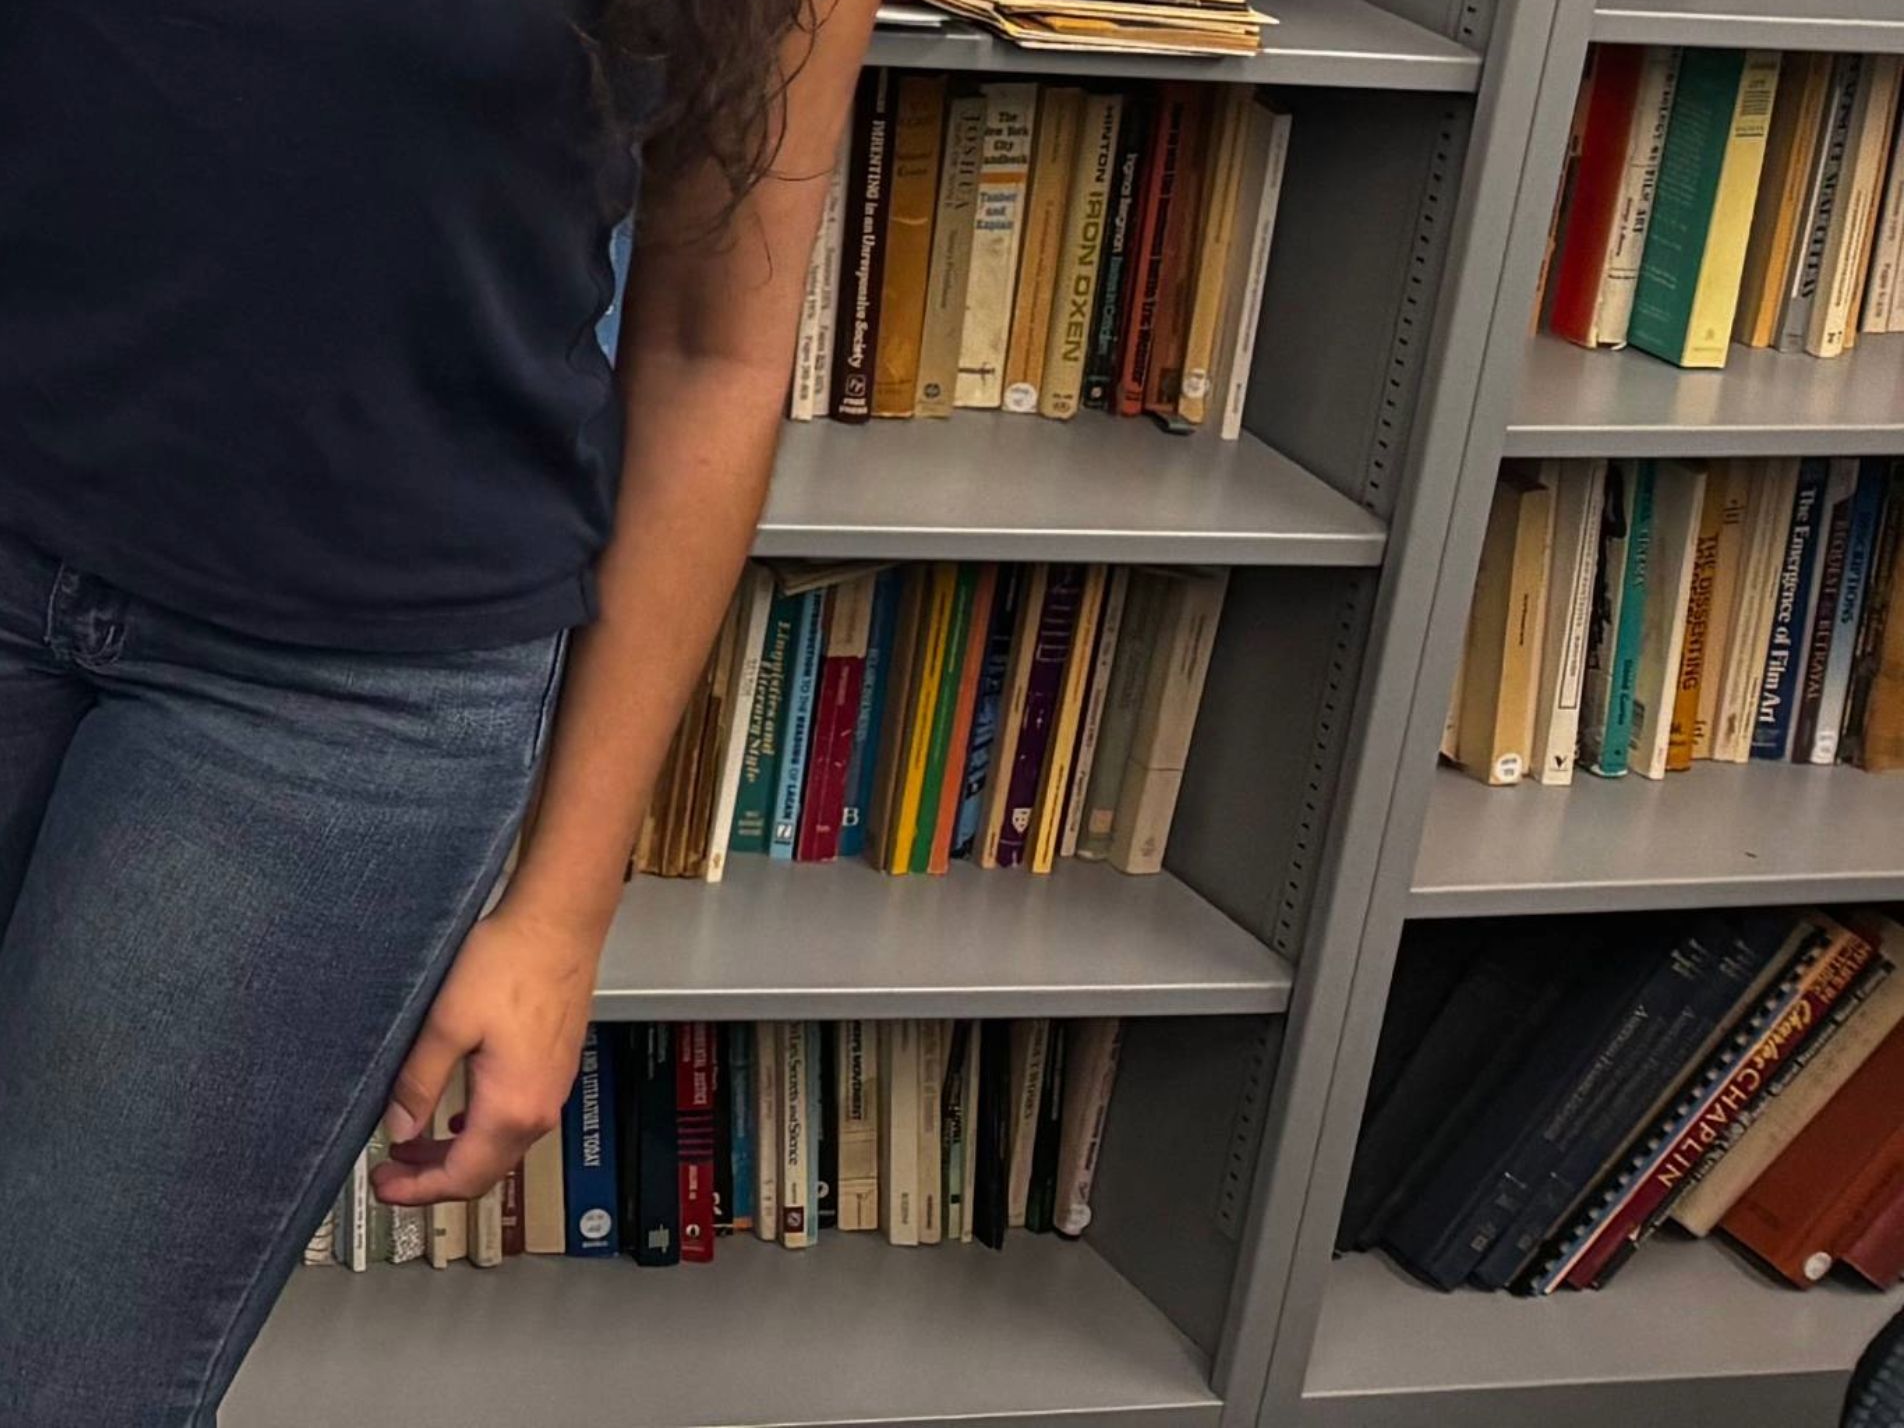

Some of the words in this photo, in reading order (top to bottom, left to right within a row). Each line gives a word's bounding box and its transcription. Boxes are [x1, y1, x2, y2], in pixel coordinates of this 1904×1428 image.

[1096, 106, 1115, 183] HINTON
[1078, 192, 1103, 266] IRON
[1062, 275, 1090, 362] OXEN
[1659, 1067, 1761, 1188] CHAPLIN
